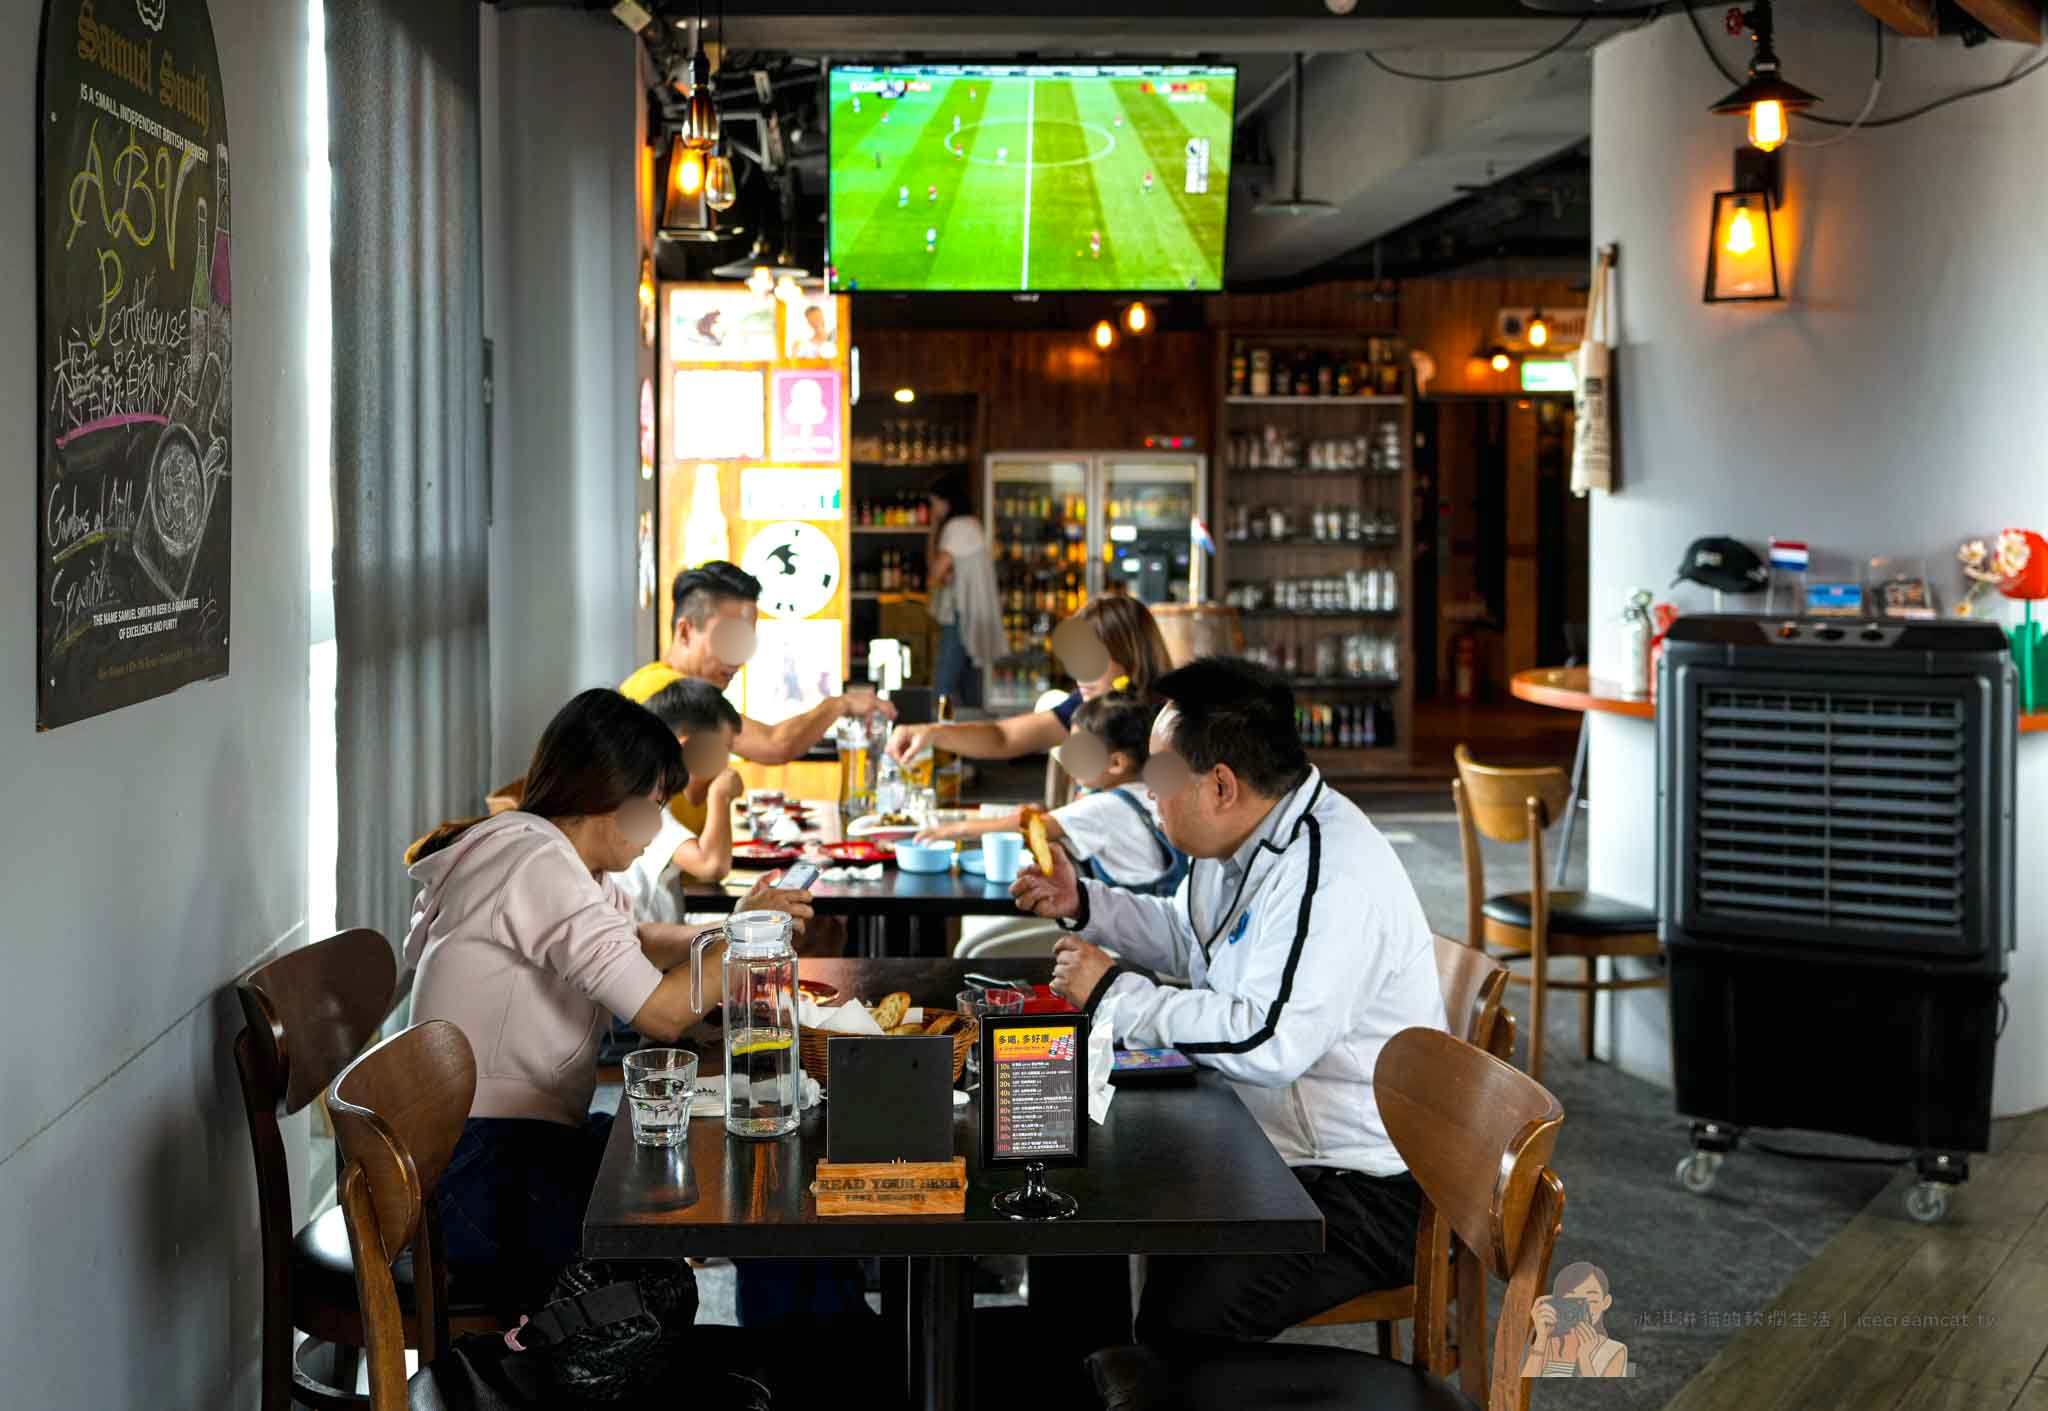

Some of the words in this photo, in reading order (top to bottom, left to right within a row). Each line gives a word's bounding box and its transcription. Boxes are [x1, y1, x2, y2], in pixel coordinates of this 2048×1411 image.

[80, 83, 87, 101] IS
[88, 87, 95, 105] A
[120, 105, 161, 140] INDEPENDENT
[162, 127, 184, 151] BRITISH
[93, 614, 103, 626] THE
[103, 611, 119, 625] NAME
[118, 609, 137, 623] SAMUEL
[137, 606, 152, 619] SMITH
[156, 604, 167, 616] BEER
[175, 598, 199, 612] GUARANTEE
[120, 628, 126, 640] OF
[126, 623, 153, 638] EXCELLENCE
[153, 622, 163, 633] AND
[163, 619, 177, 630] PURITY
[818, 1178, 866, 1191] READ
[871, 1178, 915, 1191] YOUR
